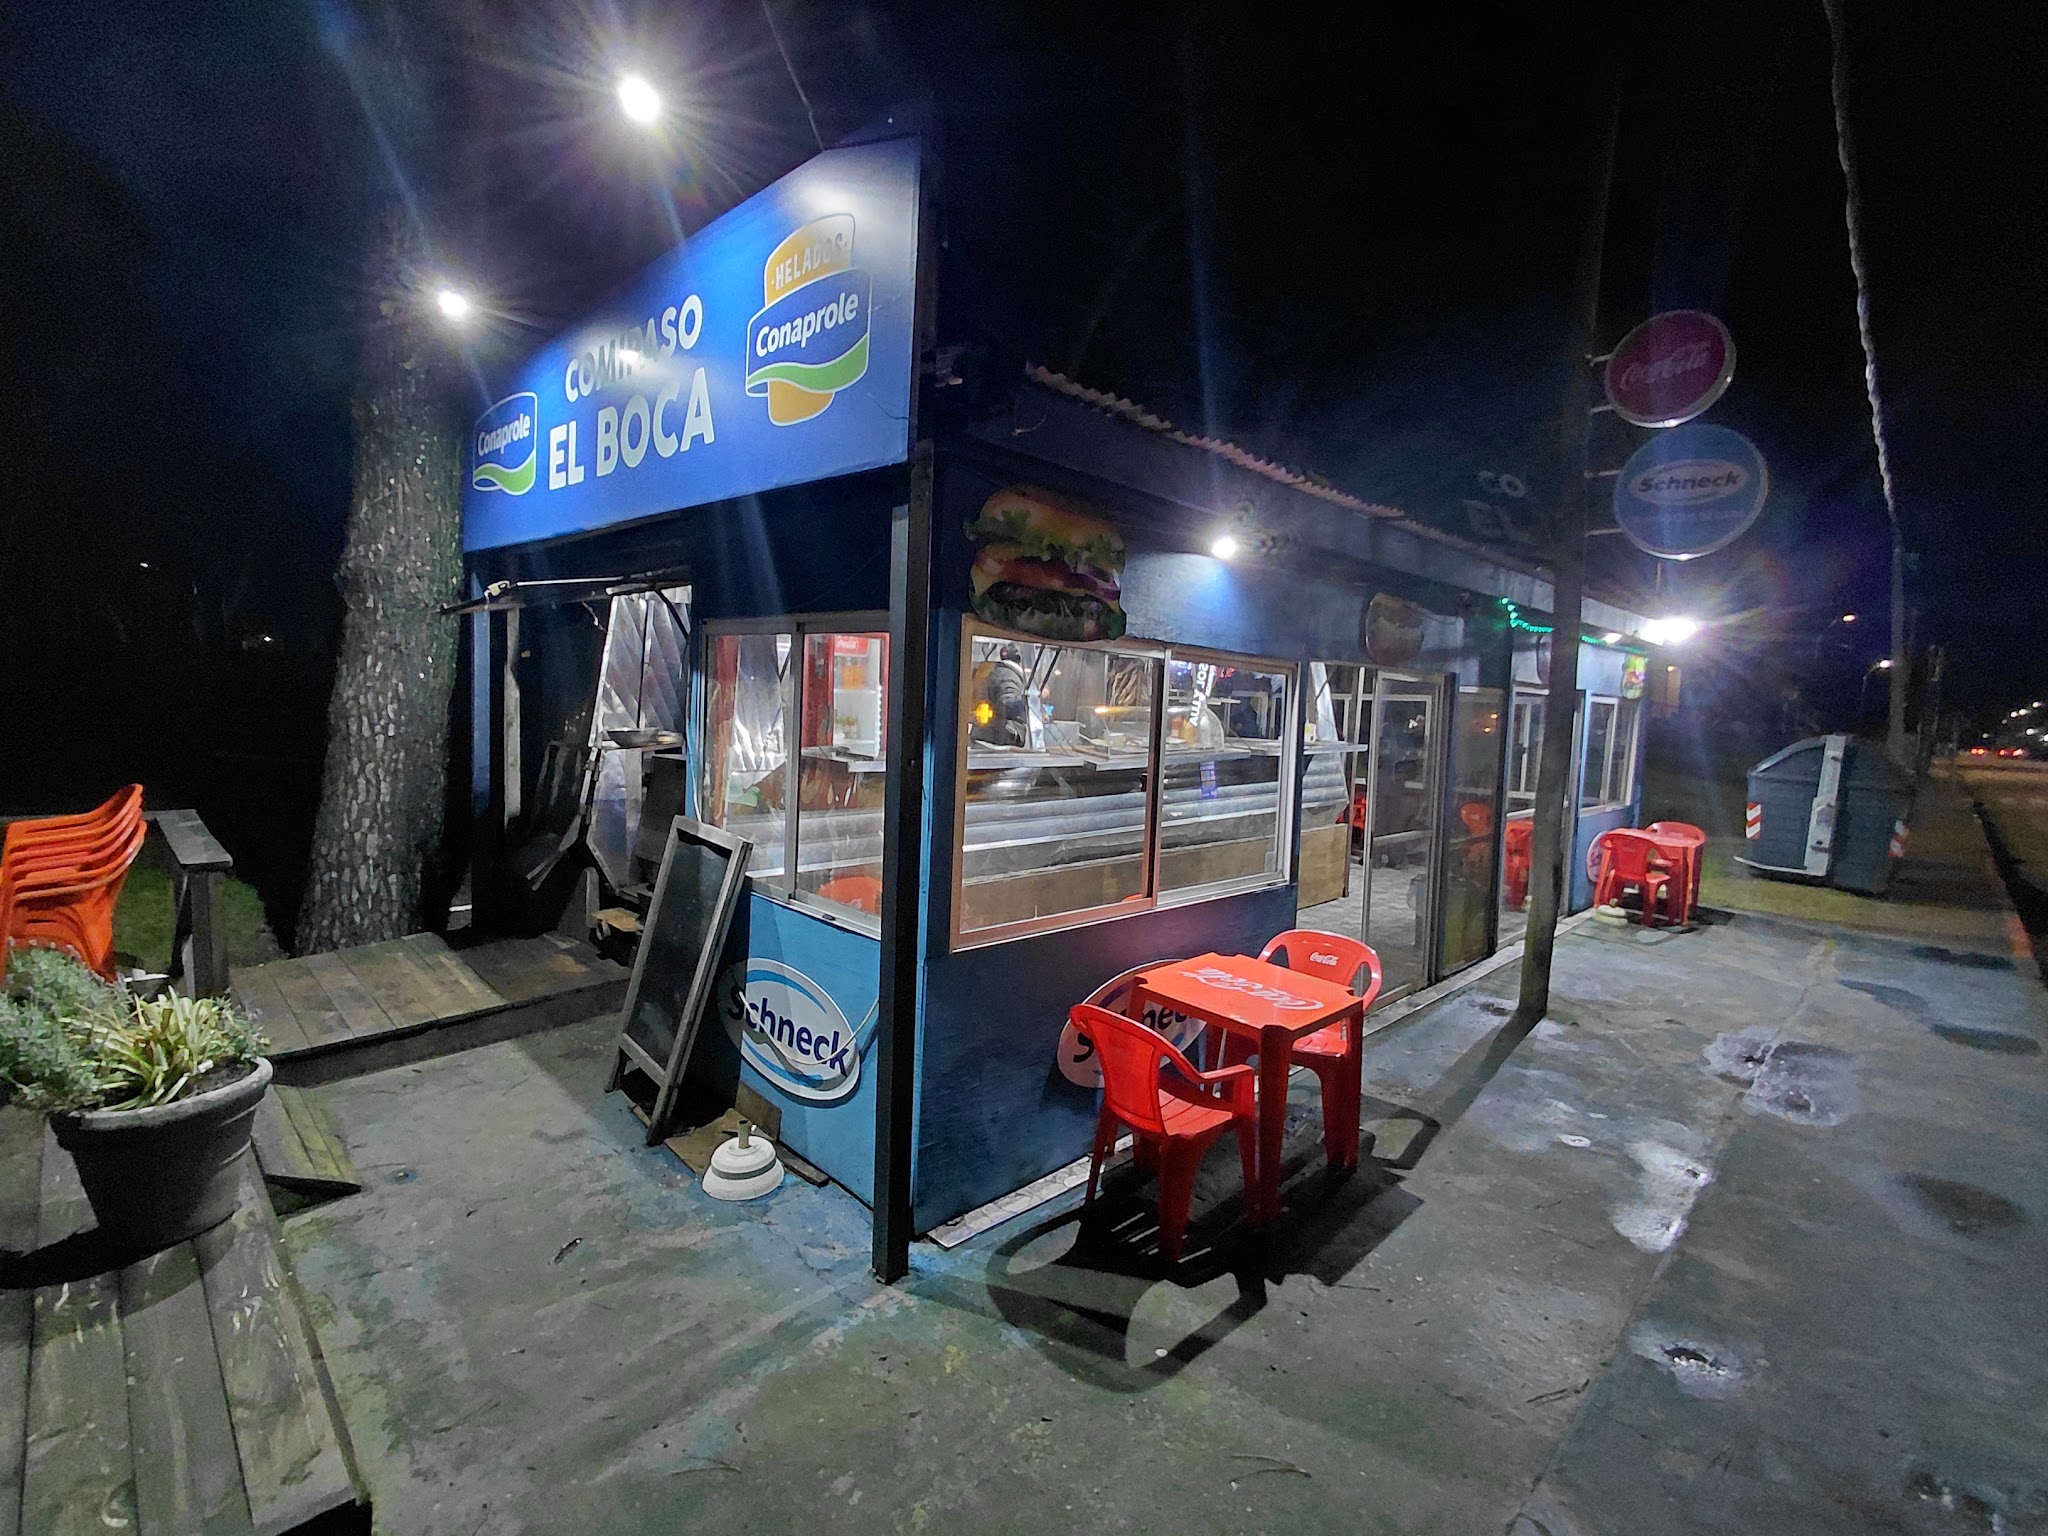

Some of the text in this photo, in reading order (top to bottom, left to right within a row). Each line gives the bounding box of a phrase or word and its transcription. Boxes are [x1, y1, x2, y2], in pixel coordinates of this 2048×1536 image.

[775, 232, 843, 290] HELADOS
[756, 292, 859, 357] Conaprole
[478, 413, 531, 456] Conaprole
[548, 366, 715, 490] EL BOCA
[1638, 470, 1741, 493] Schneck
[728, 984, 850, 1078] Schneck
